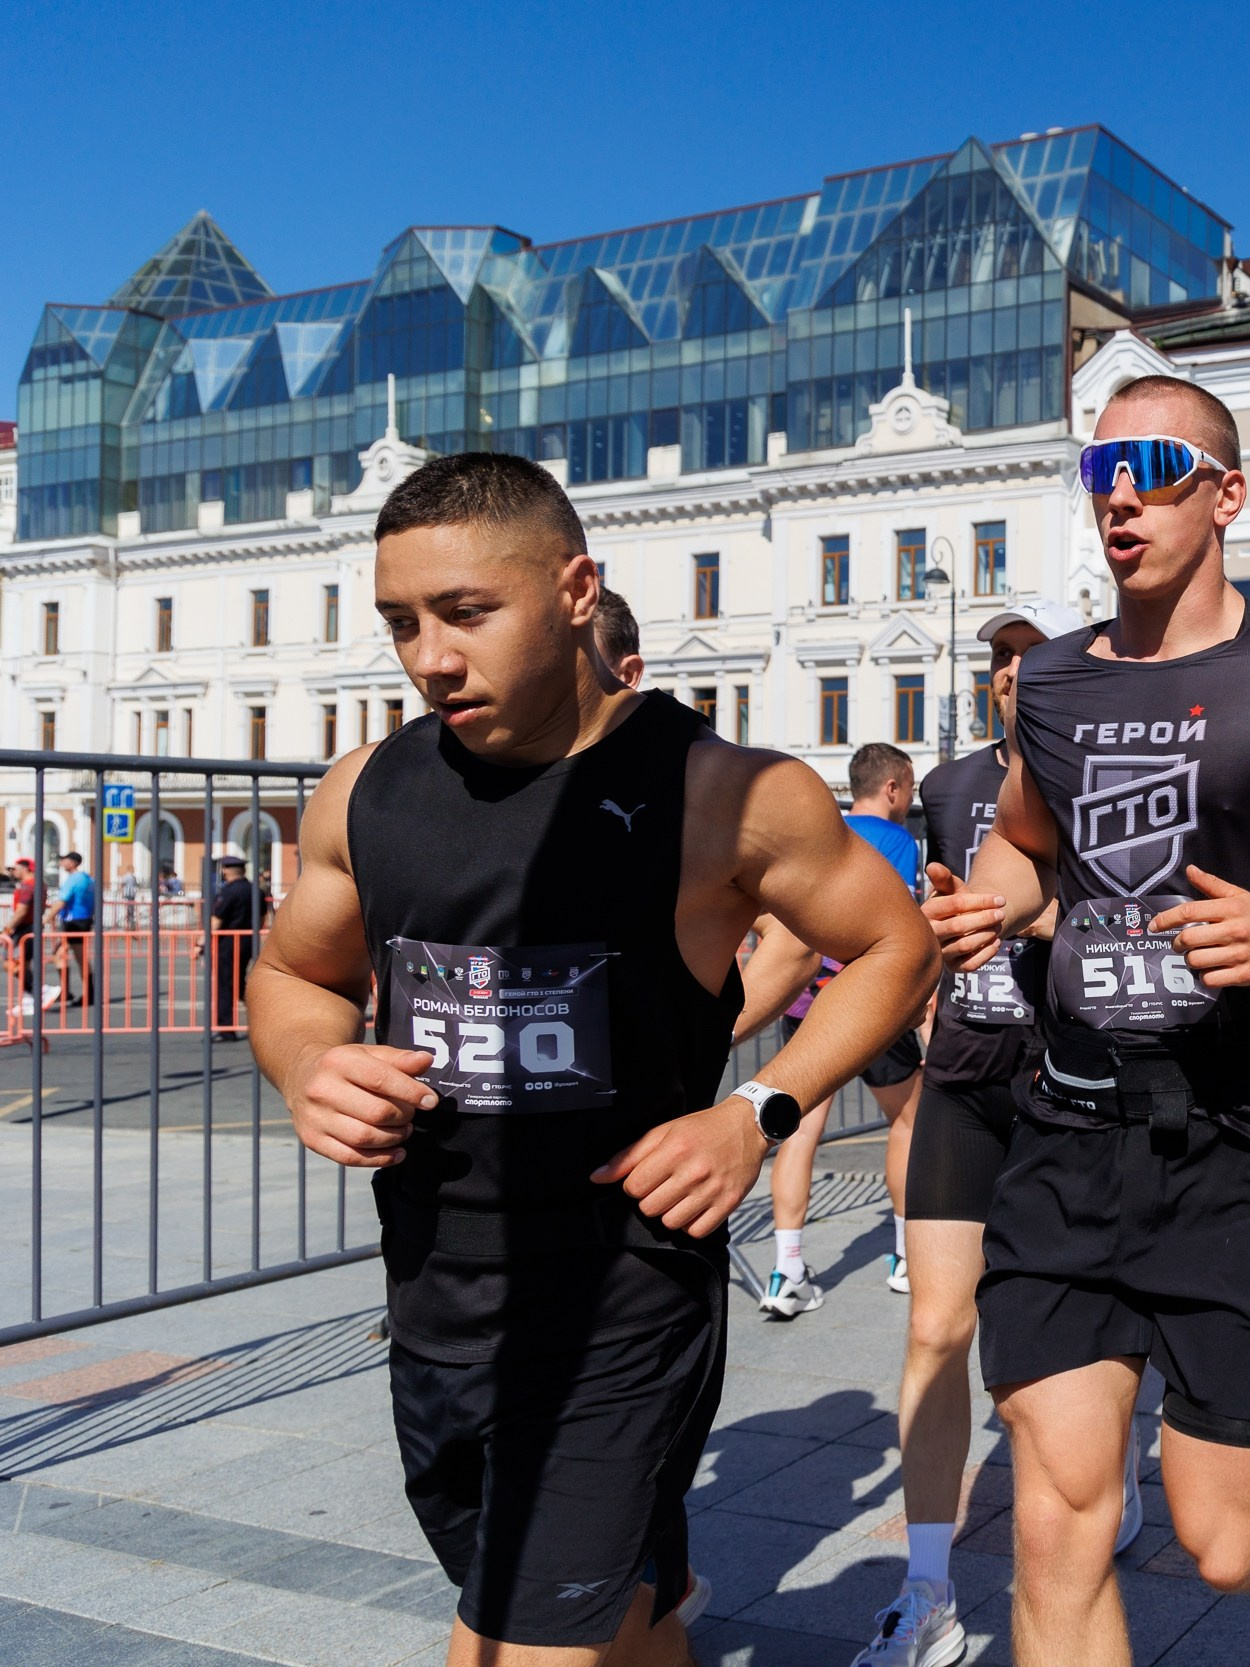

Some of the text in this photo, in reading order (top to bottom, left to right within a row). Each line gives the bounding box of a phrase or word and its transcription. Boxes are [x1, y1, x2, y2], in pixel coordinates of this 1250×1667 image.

[1073, 704, 1208, 744] ГЕРОЙ
[1088, 784, 1179, 848] ГТО
[1086, 940, 1173, 954] НИКИТА САЛМИ
[977, 964, 1006, 972] ИЖУК
[1082, 954, 1196, 998] 516
[954, 972, 1015, 1003] 512
[413, 998, 570, 1016] РОМАН БЕЛОНОСОВ
[412, 1015, 575, 1074] 520
[464, 1098, 513, 1107] спортлото
